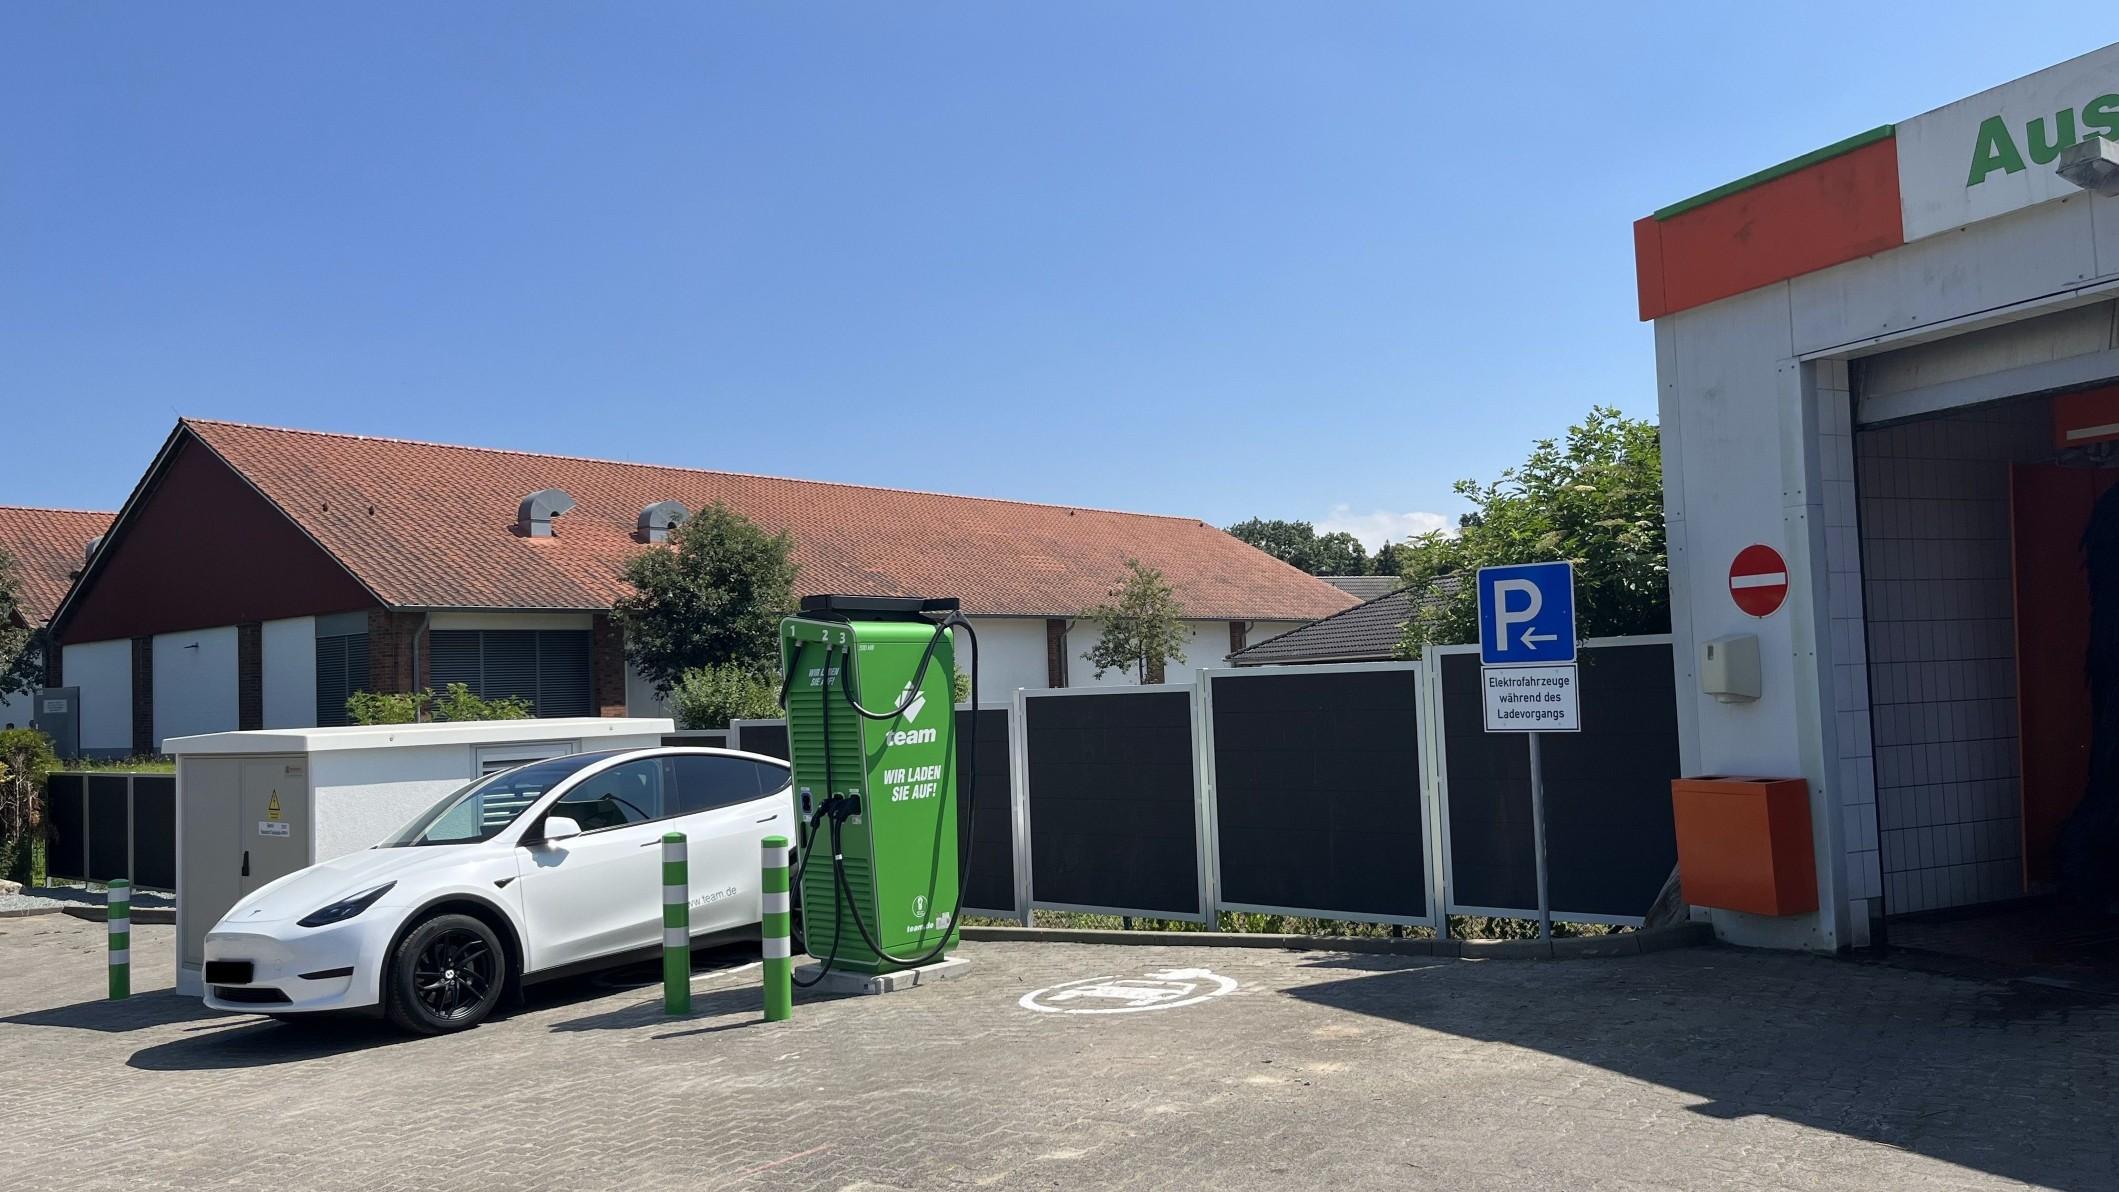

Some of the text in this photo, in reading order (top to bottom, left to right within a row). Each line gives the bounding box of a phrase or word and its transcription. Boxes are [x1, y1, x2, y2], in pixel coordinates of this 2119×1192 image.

[1967, 93, 2119, 187] Aus
[1493, 579, 1542, 651] P
[790, 625, 846, 644] 1 2 3
[820, 667, 840, 677] LDEN
[1489, 676, 1570, 689] Elektrofahrzeuge
[1499, 691, 1561, 703] während des
[1497, 708, 1565, 721] Ladevorgangs
[885, 728, 936, 746] team
[884, 765, 941, 784] WIR LADEN
[892, 783, 937, 801] SIE AUF!
